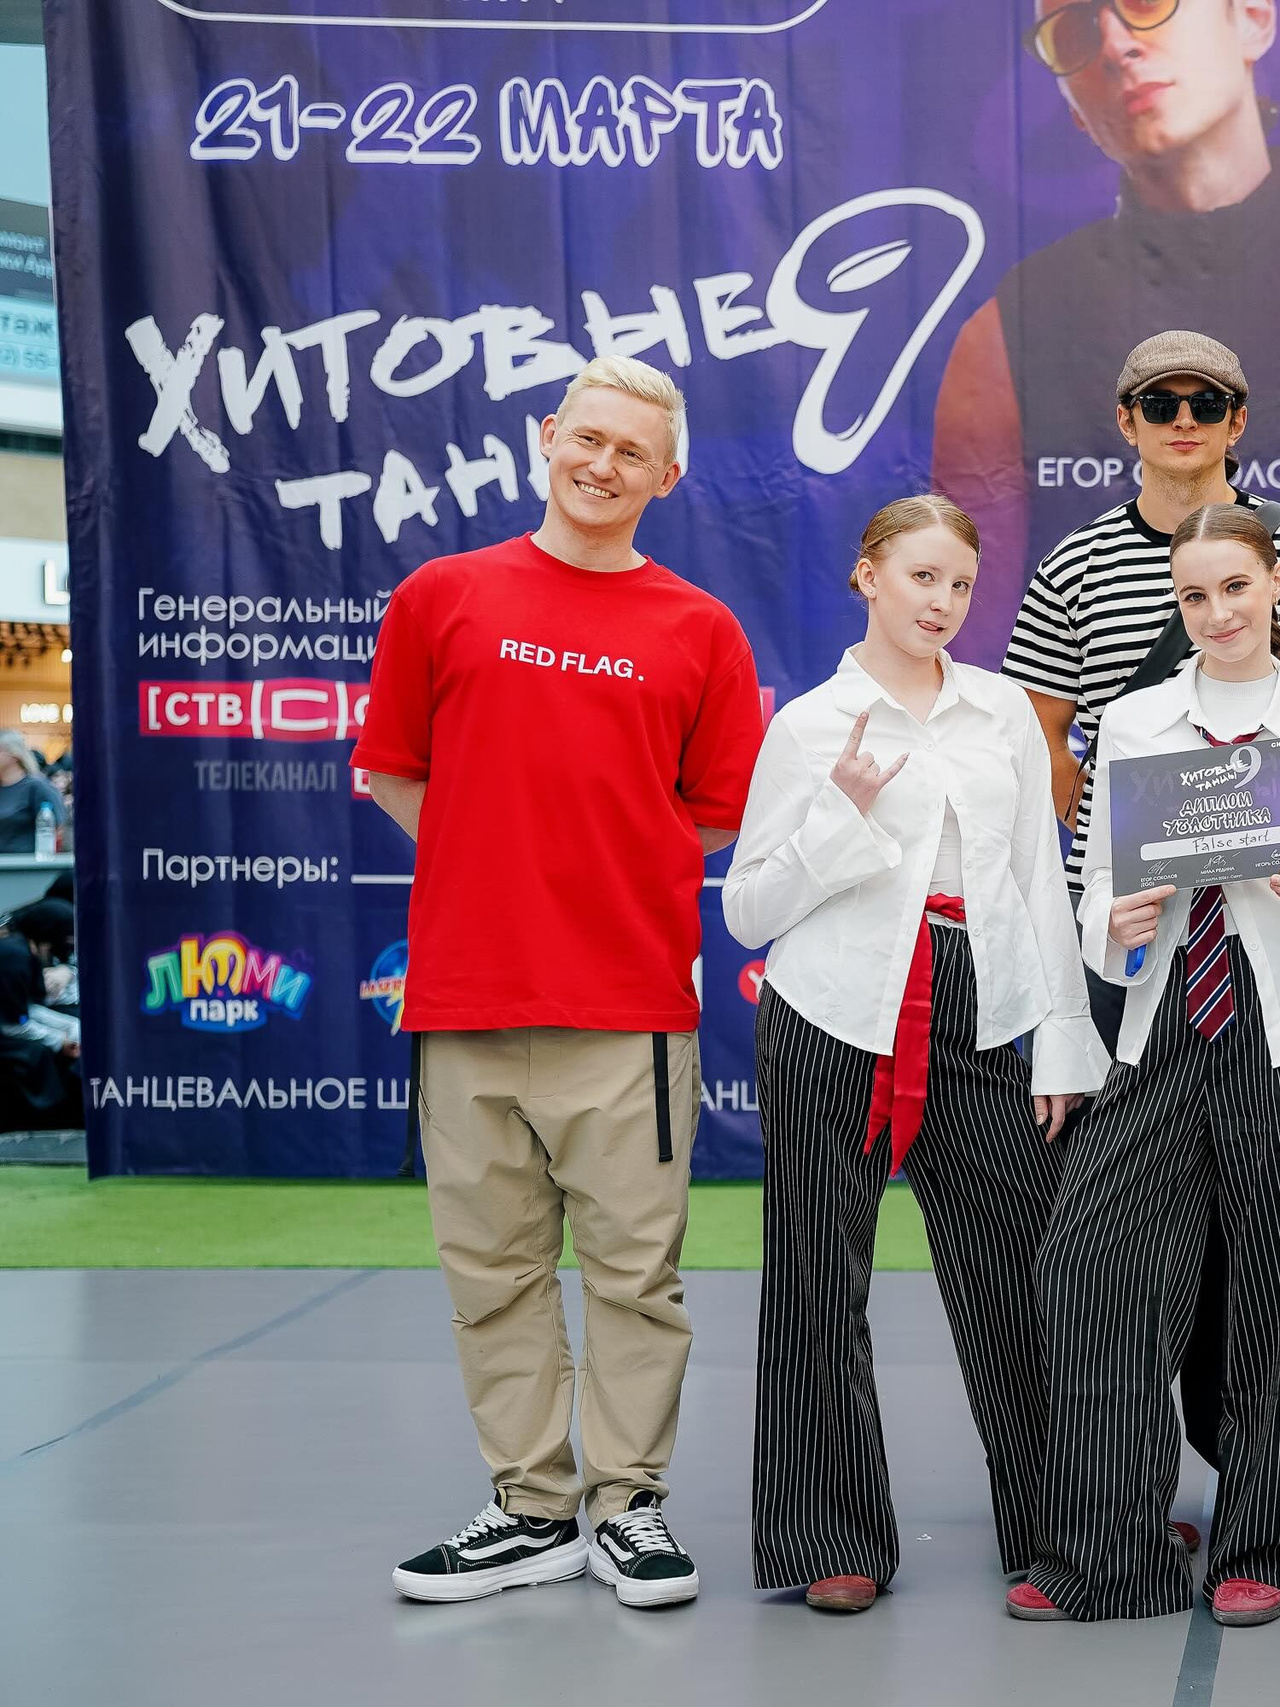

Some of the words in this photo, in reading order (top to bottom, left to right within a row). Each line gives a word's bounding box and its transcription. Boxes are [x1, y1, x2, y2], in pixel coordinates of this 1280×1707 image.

[189, 74, 483, 166] 21-22
[501, 75, 786, 170] МАРТА
[125, 272, 793, 473] ХИТОВЫЕ
[1037, 457, 1123, 488] ЕГОР
[500, 638, 556, 667] RED
[194, 760, 337, 792] ТЕЛЕКАНАЛ
[1179, 790, 1254, 818] ДИПЛОМ
[142, 847, 339, 889] Партнеры:
[146, 939, 311, 1009] ЛЮМИ
[189, 999, 259, 1027] парк
[90, 1075, 367, 1112] ТАНЦЕВАЛЬНОЕ
